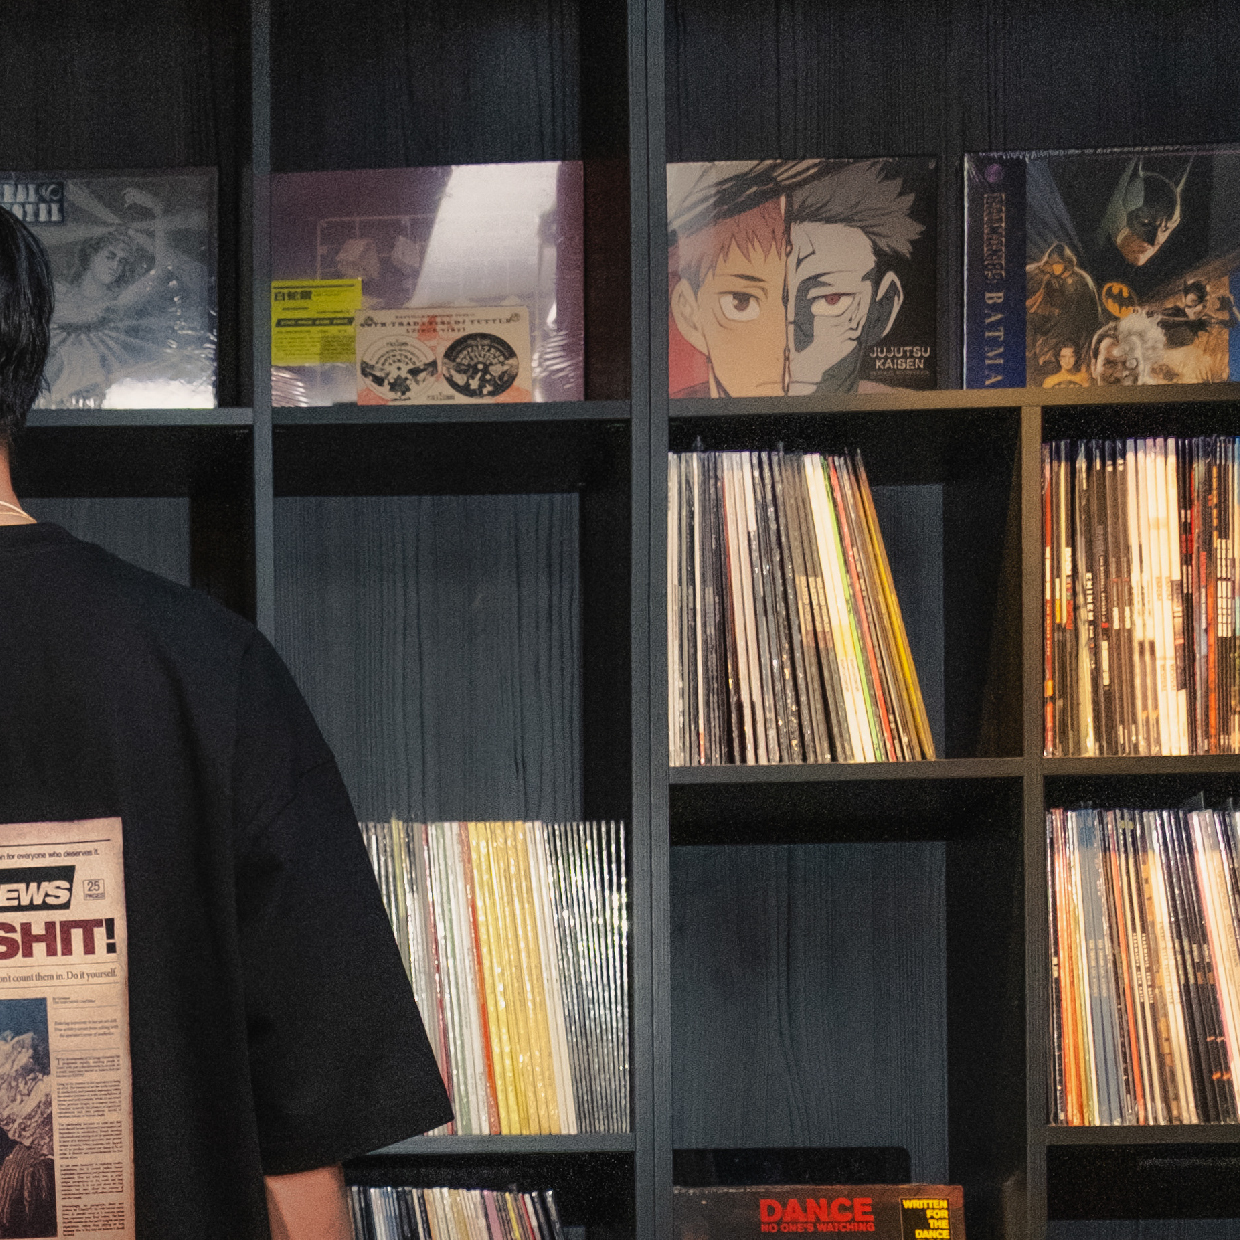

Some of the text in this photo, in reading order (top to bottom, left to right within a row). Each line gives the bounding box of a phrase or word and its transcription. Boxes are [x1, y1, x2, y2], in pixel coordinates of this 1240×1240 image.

[984, 292, 1005, 386] BATMA
[869, 346, 931, 358] JUJUTSU
[875, 358, 925, 370] KAISEN
[17, 852, 46, 861] everyone
[48, 850, 62, 858] who
[87, 880, 100, 892] 25
[12, 973, 34, 983] count
[35, 972, 54, 982] them
[66, 971, 78, 980] Do
[79, 970, 85, 980] it
[86, 967, 118, 982] yourself.
[760, 1197, 875, 1222] DANCE
[902, 1199, 948, 1209] WRITTEN
[926, 1209, 949, 1219] FOR
[761, 1222, 875, 1232] NO ONE'S WATCHING
[928, 1219, 950, 1229] THE
[915, 1229, 950, 1239] DANCE
